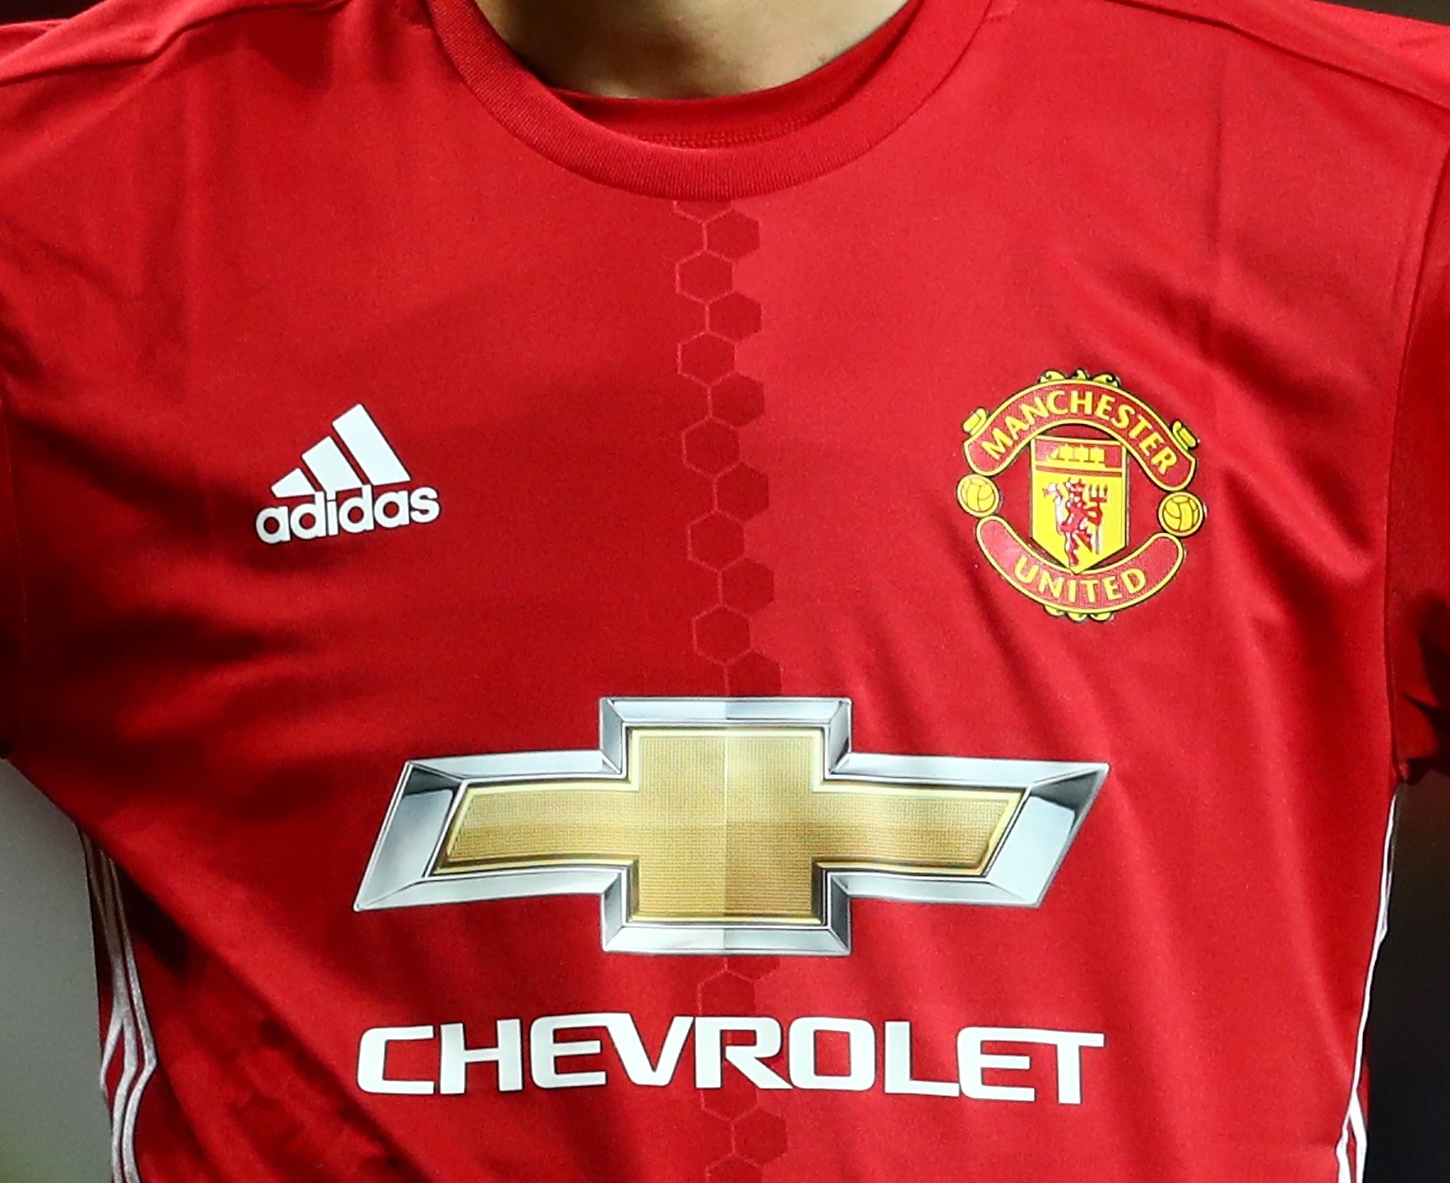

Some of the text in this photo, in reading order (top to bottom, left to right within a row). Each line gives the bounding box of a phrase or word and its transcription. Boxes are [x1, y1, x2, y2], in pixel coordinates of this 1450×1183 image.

[981, 390, 1178, 475] MANCHESTER
[255, 484, 440, 544] adidas
[1014, 554, 1146, 603] UNITED
[356, 1012, 1105, 1105] CHEVROLET
